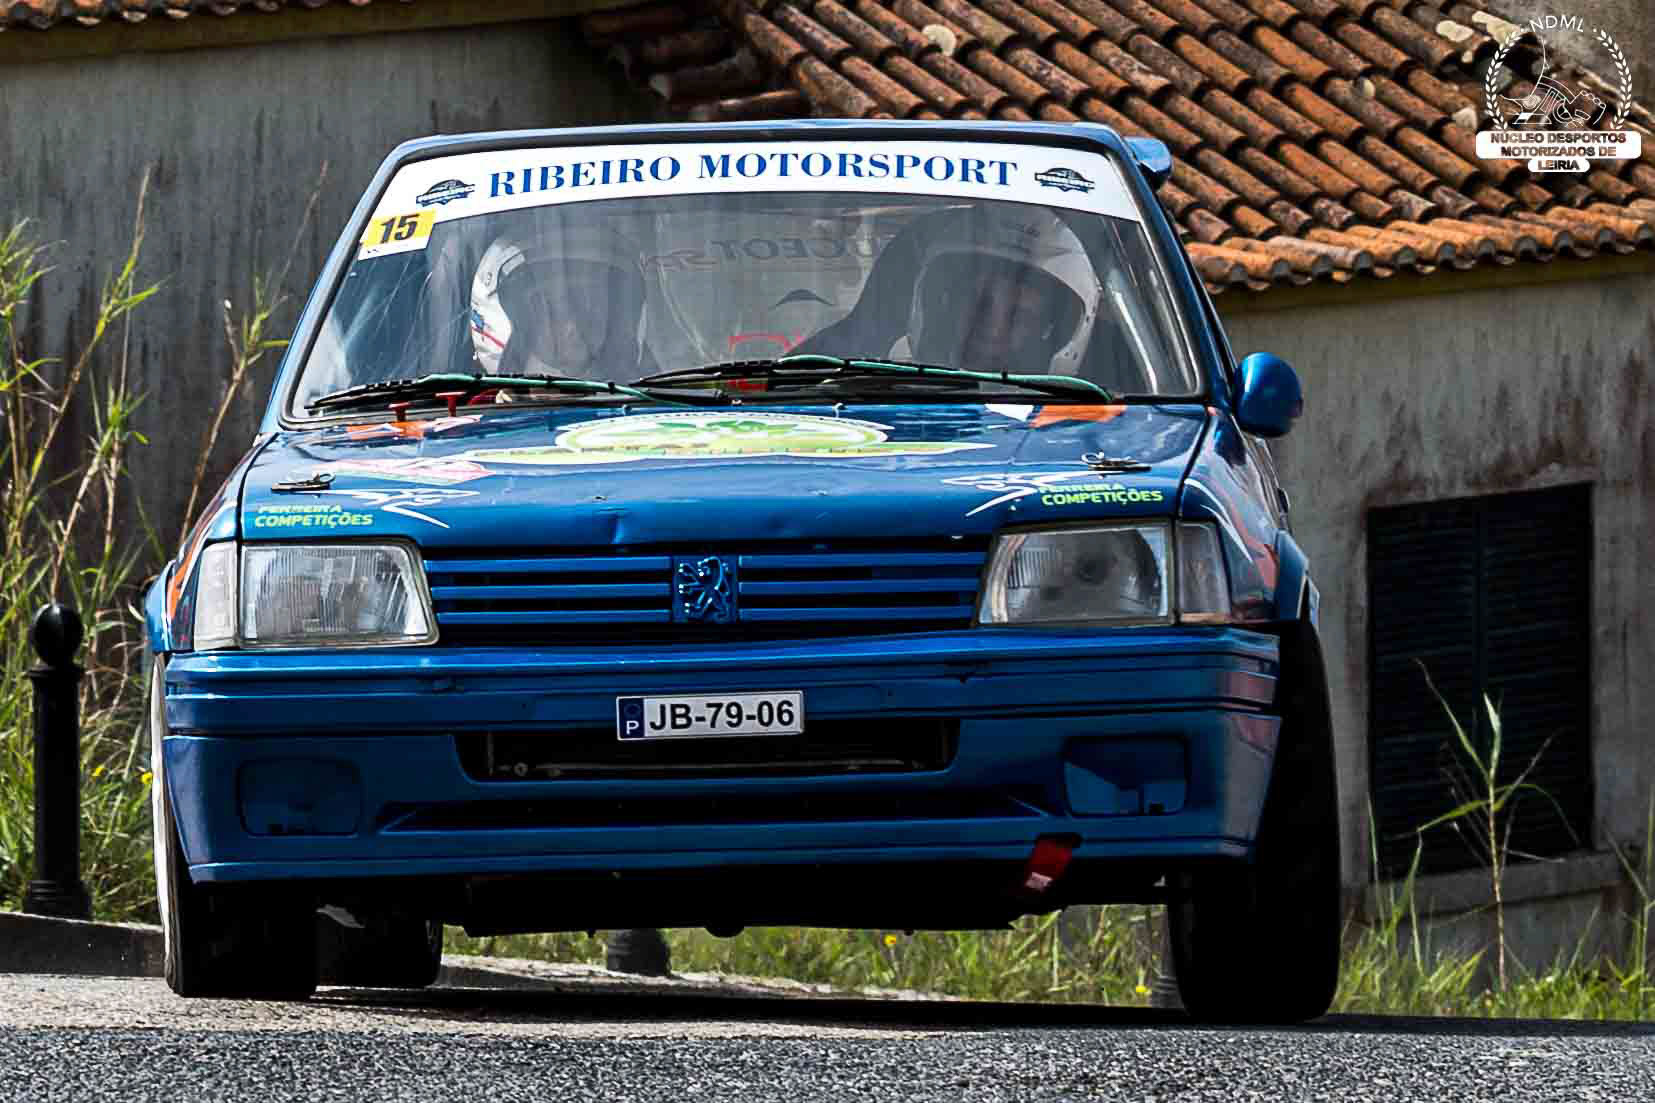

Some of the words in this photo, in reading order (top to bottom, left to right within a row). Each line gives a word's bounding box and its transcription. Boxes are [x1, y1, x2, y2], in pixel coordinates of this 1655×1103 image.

[488, 156, 681, 199] RIBEIRO
[697, 153, 1018, 187] MOTORSPORT
[380, 213, 420, 244] 15
[1042, 489, 1163, 506] COMPETIÇÕES
[255, 512, 374, 528] COMPETIÇÕES
[626, 720, 640, 735] P
[649, 700, 795, 730] JB-79-06
